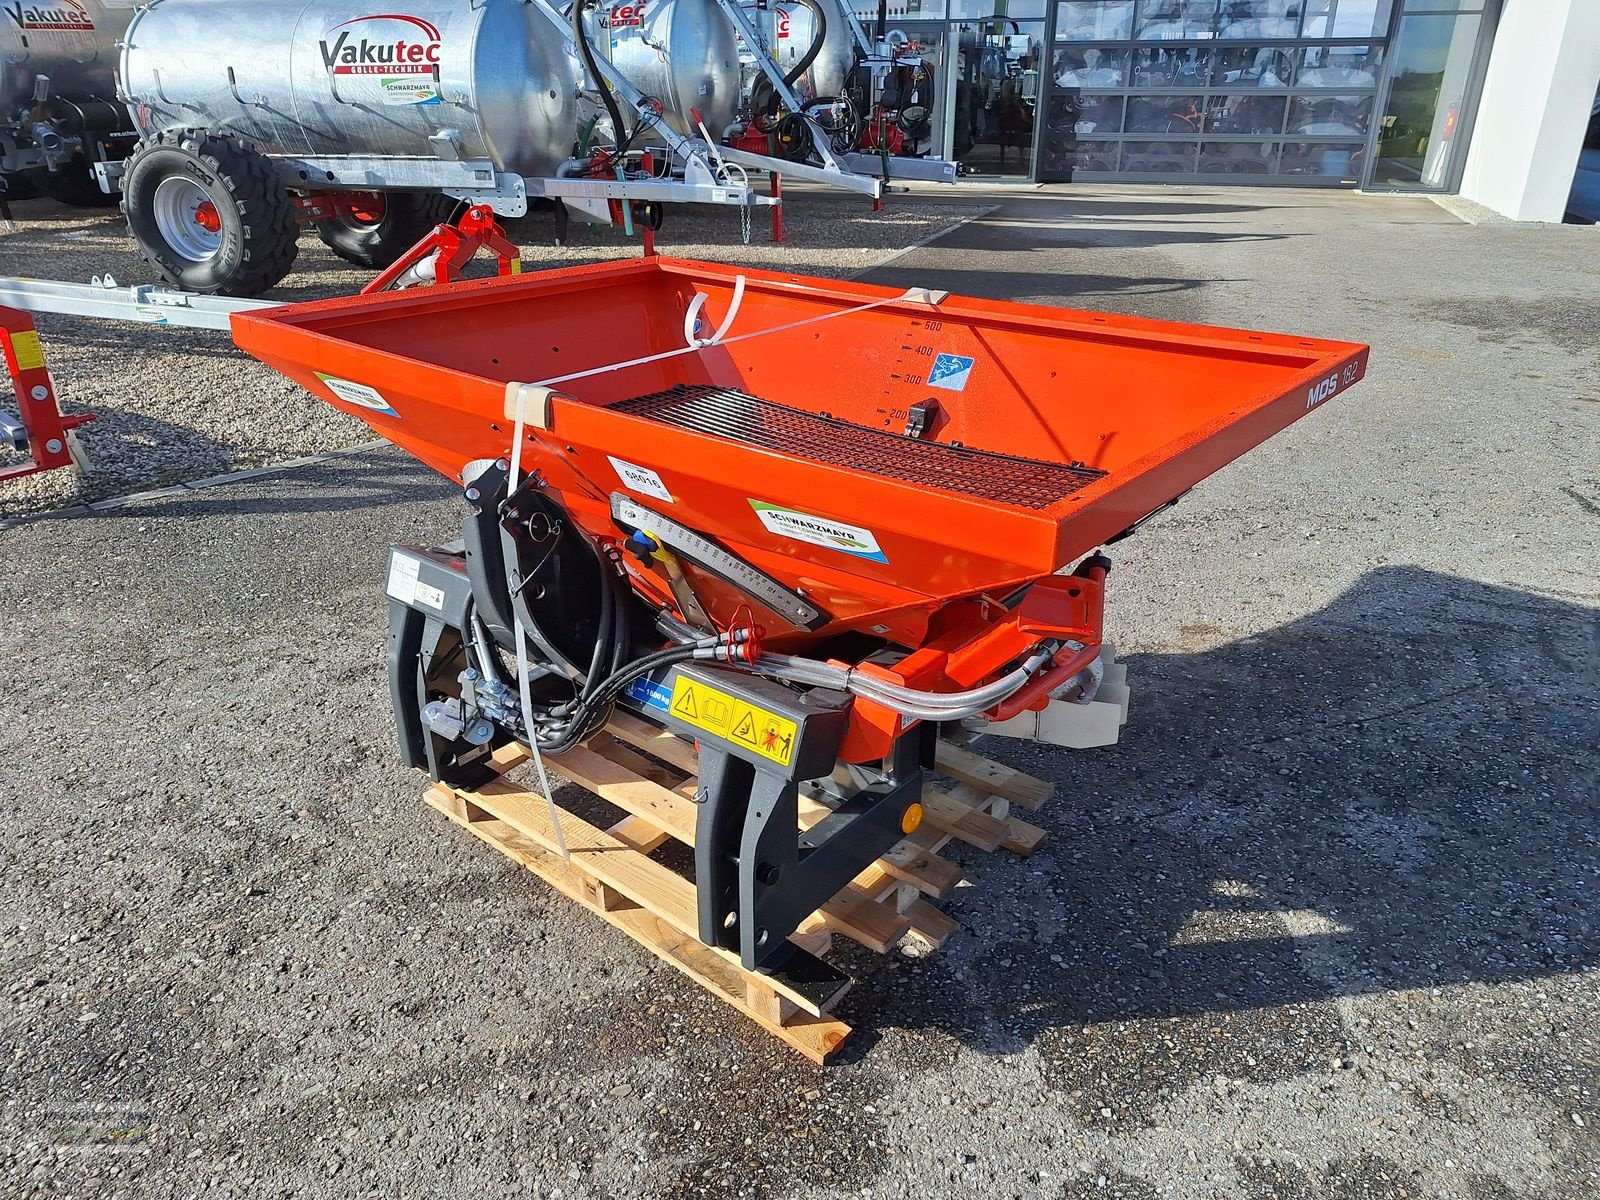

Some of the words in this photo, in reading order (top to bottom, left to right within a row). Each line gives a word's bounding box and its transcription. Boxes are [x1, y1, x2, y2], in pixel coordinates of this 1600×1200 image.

[4, 0, 91, 29] Vakutec
[319, 31, 441, 72] Vakutec
[925, 321, 942, 332] 500
[915, 346, 933, 356] 400
[904, 374, 922, 385] 300
[1306, 373, 1338, 408] MDS
[890, 409, 908, 420] 200
[624, 470, 661, 489] 68016
[767, 511, 856, 541] SCHWARZMAYR
[661, 694, 670, 706] kg
